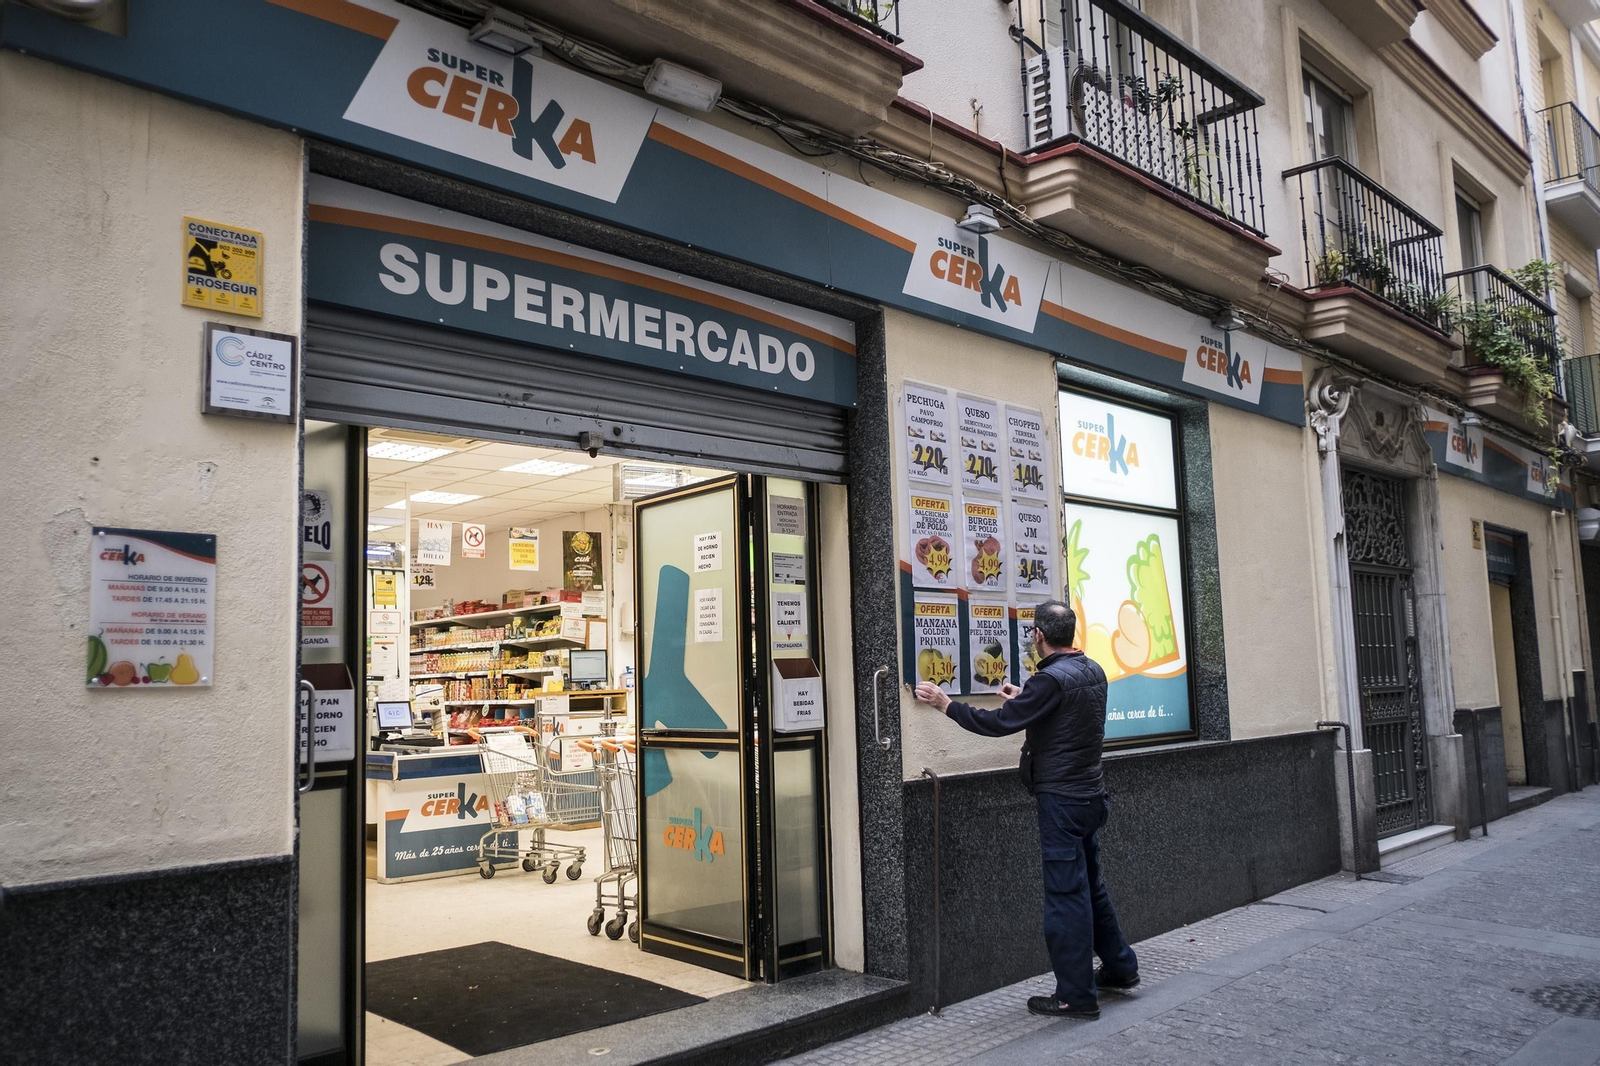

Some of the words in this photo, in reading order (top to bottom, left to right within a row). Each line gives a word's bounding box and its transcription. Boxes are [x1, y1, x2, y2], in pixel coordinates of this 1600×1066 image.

[427, 48, 504, 88] SUPER
[188, 222, 258, 244] CONECTADA
[937, 237, 976, 259] SUPER
[187, 275, 258, 296] PROSEGUR
[378, 242, 816, 382] SUPERMERCADO
[1200, 334, 1224, 350] SUPER
[246, 349, 273, 361] CÁDIZ
[250, 359, 286, 371] CENTRO
[906, 393, 945, 410] PECHUGA
[919, 408, 935, 417] PAVO
[965, 406, 990, 420] QUESO
[911, 415, 944, 428] CAMPOFRIO
[964, 419, 993, 430] SEMICURADO
[1008, 417, 1040, 431] CHOPPED
[1077, 420, 1105, 434] SUPER
[977, 428, 998, 438] BAQUERO
[1014, 429, 1036, 439] TERNERA
[1012, 436, 1040, 448] CAMPOFRIO
[776, 503, 798, 511] HORARIO
[915, 498, 946, 510] OFERTA
[915, 509, 949, 519] SALCHICHAS
[967, 505, 995, 516] OFERTA
[921, 516, 946, 525] FRESCAS
[968, 516, 998, 527] BURGER
[1018, 512, 1042, 524] QUESO
[427, 522, 444, 530] HAY
[916, 521, 926, 530] DE
[927, 522, 948, 532] POLLO
[968, 525, 981, 533] DE
[981, 525, 998, 534] POLLO
[304, 520, 331, 551] ELO
[912, 529, 933, 537] BLANCAS
[1024, 527, 1038, 539] JM
[423, 552, 444, 561] HIELO
[928, 553, 949, 568] 4,99
[127, 574, 162, 582] HORARIO
[108, 583, 146, 592] MAÑANAS
[112, 595, 142, 603] TARDES
[920, 604, 950, 614] OFERTA
[974, 607, 1002, 617] OFERTA
[1021, 610, 1035, 619] OFE
[915, 618, 958, 628] MANZANA
[976, 620, 1002, 629] MELON
[106, 627, 144, 635] MAÑANAS
[922, 628, 950, 636] GOLDEN
[969, 628, 984, 636] PIEL
[984, 629, 992, 637] DE
[992, 629, 1008, 637] SAPO
[110, 638, 140, 646] TARDES
[301, 637, 329, 645] GANDA
[919, 636, 957, 646] PRIMERA
[979, 636, 999, 645] PERIS
[320, 698, 339, 706] PAN
[315, 711, 343, 720] ORNO
[1107, 707, 1126, 721] años
[1127, 709, 1146, 719] cerca
[1147, 705, 1157, 718] de
[301, 725, 336, 734] RCIEN
[301, 739, 328, 748] EHO
[427, 791, 456, 800] SUPER
[394, 849, 417, 861] Más
[419, 848, 430, 858] de
[431, 846, 445, 857] 25
[444, 844, 464, 855] años
